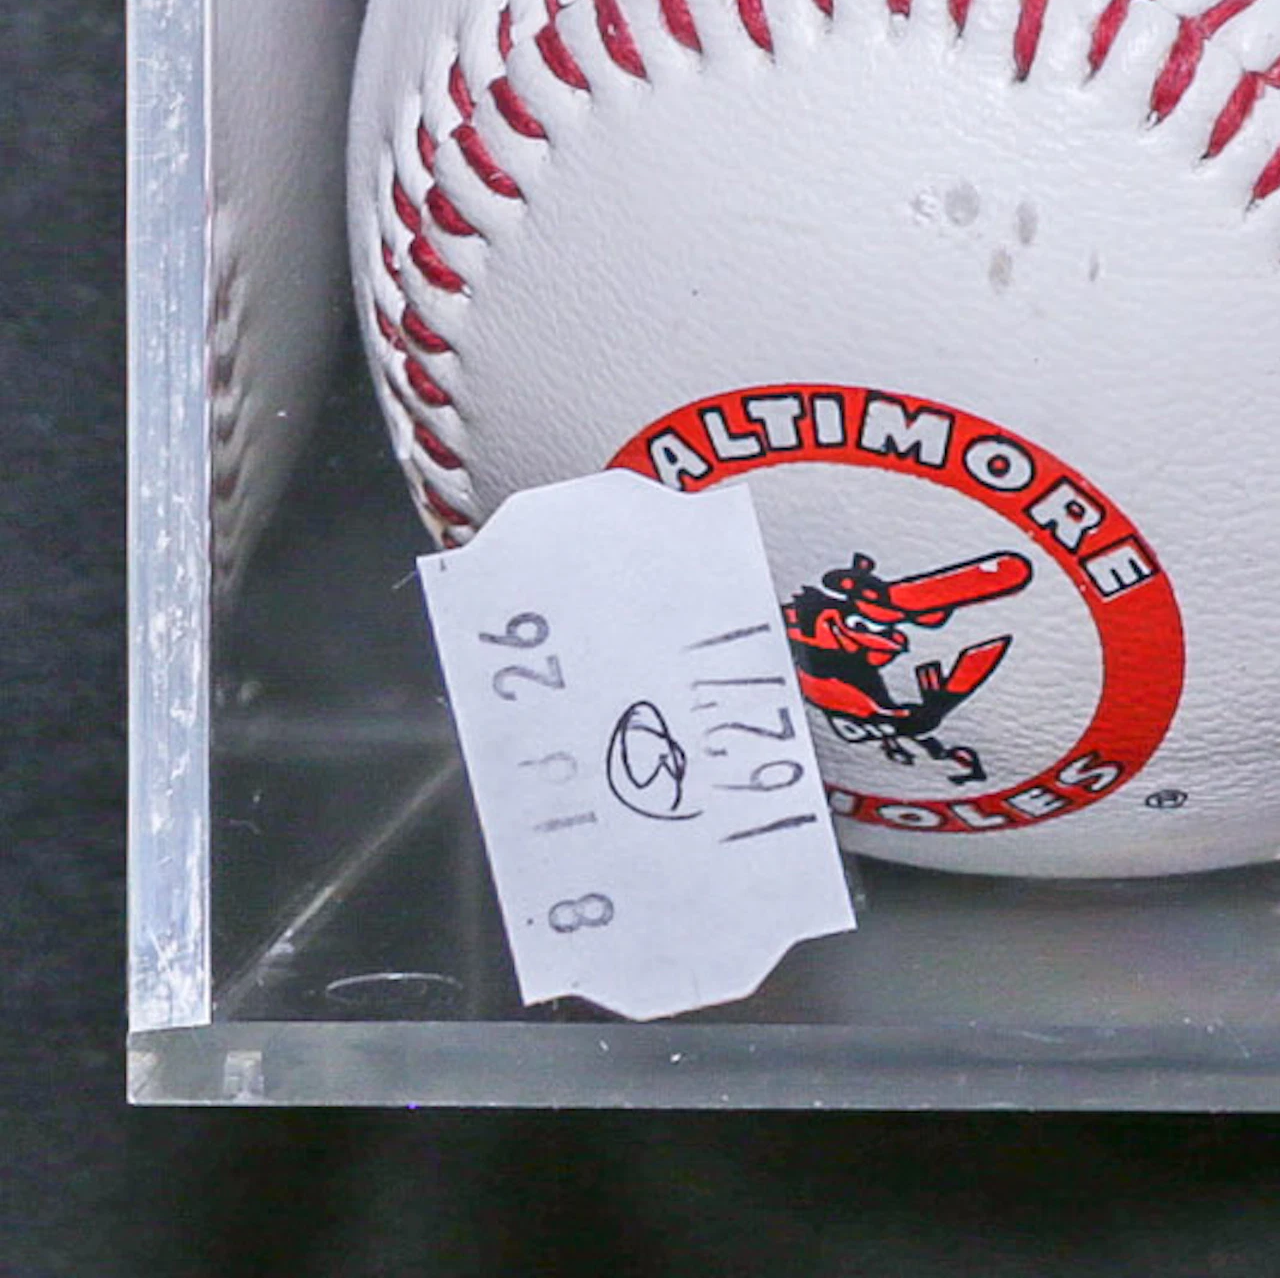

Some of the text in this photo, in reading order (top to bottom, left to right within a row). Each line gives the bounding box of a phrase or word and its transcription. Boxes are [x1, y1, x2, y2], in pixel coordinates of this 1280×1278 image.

[647, 388, 1160, 599] ALTIMORE
[477, 609, 566, 705] 26
[680, 621, 818, 844] 16271
[827, 750, 1125, 831] IOLES
[546, 892, 616, 935] 8
